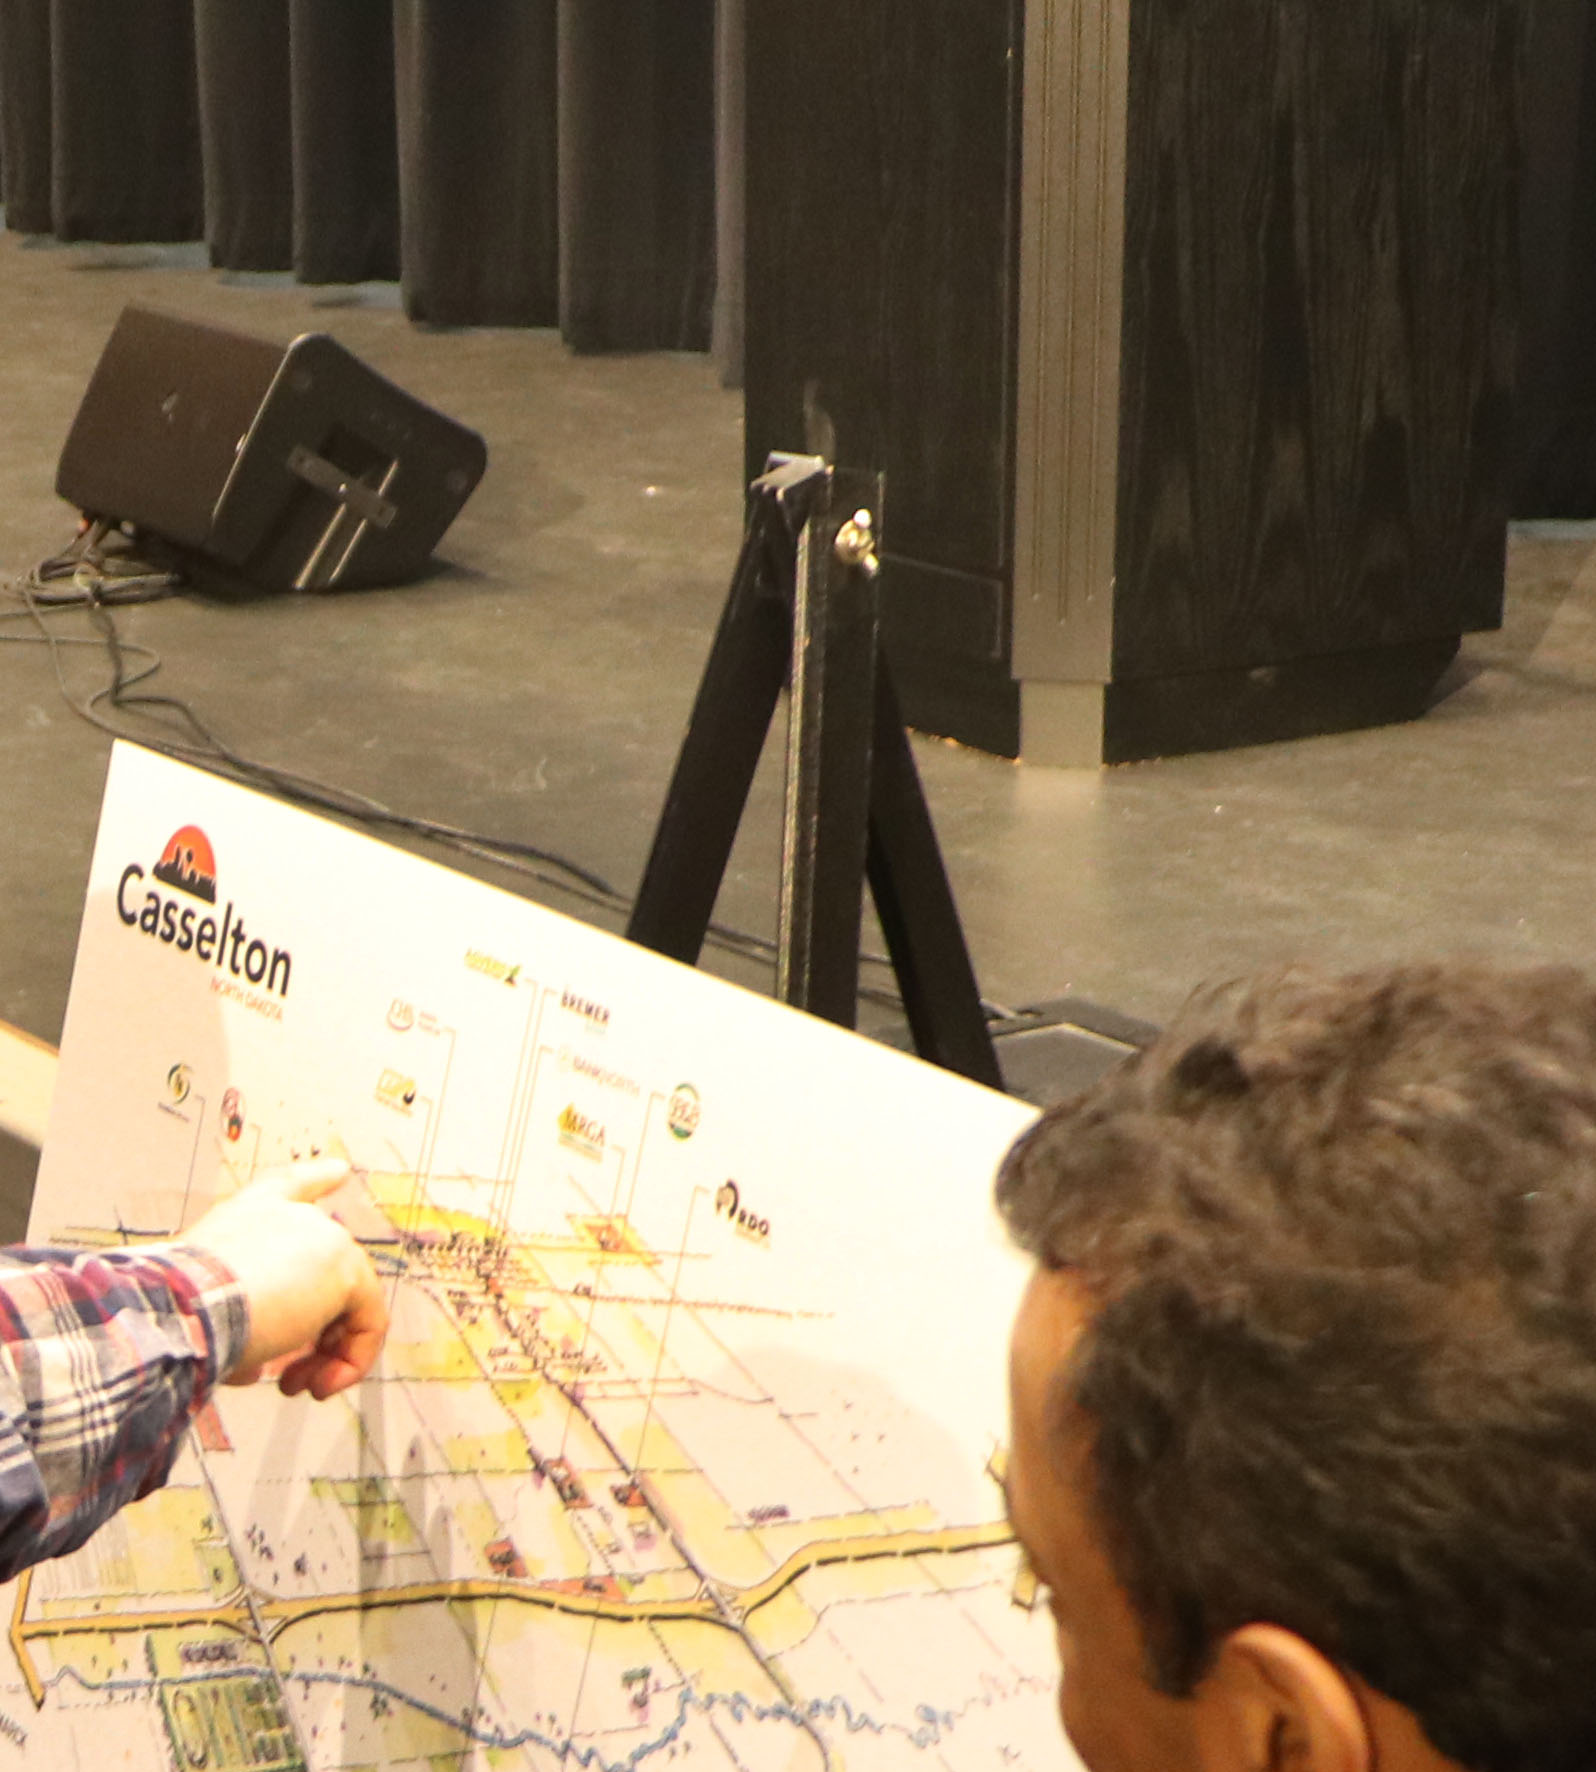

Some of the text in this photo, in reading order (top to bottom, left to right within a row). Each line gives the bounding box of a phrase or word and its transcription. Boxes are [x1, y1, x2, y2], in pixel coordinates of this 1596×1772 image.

[116, 863, 292, 997] Casselton
[561, 989, 610, 1024] BREMER
[738, 1208, 770, 1236] RDO
